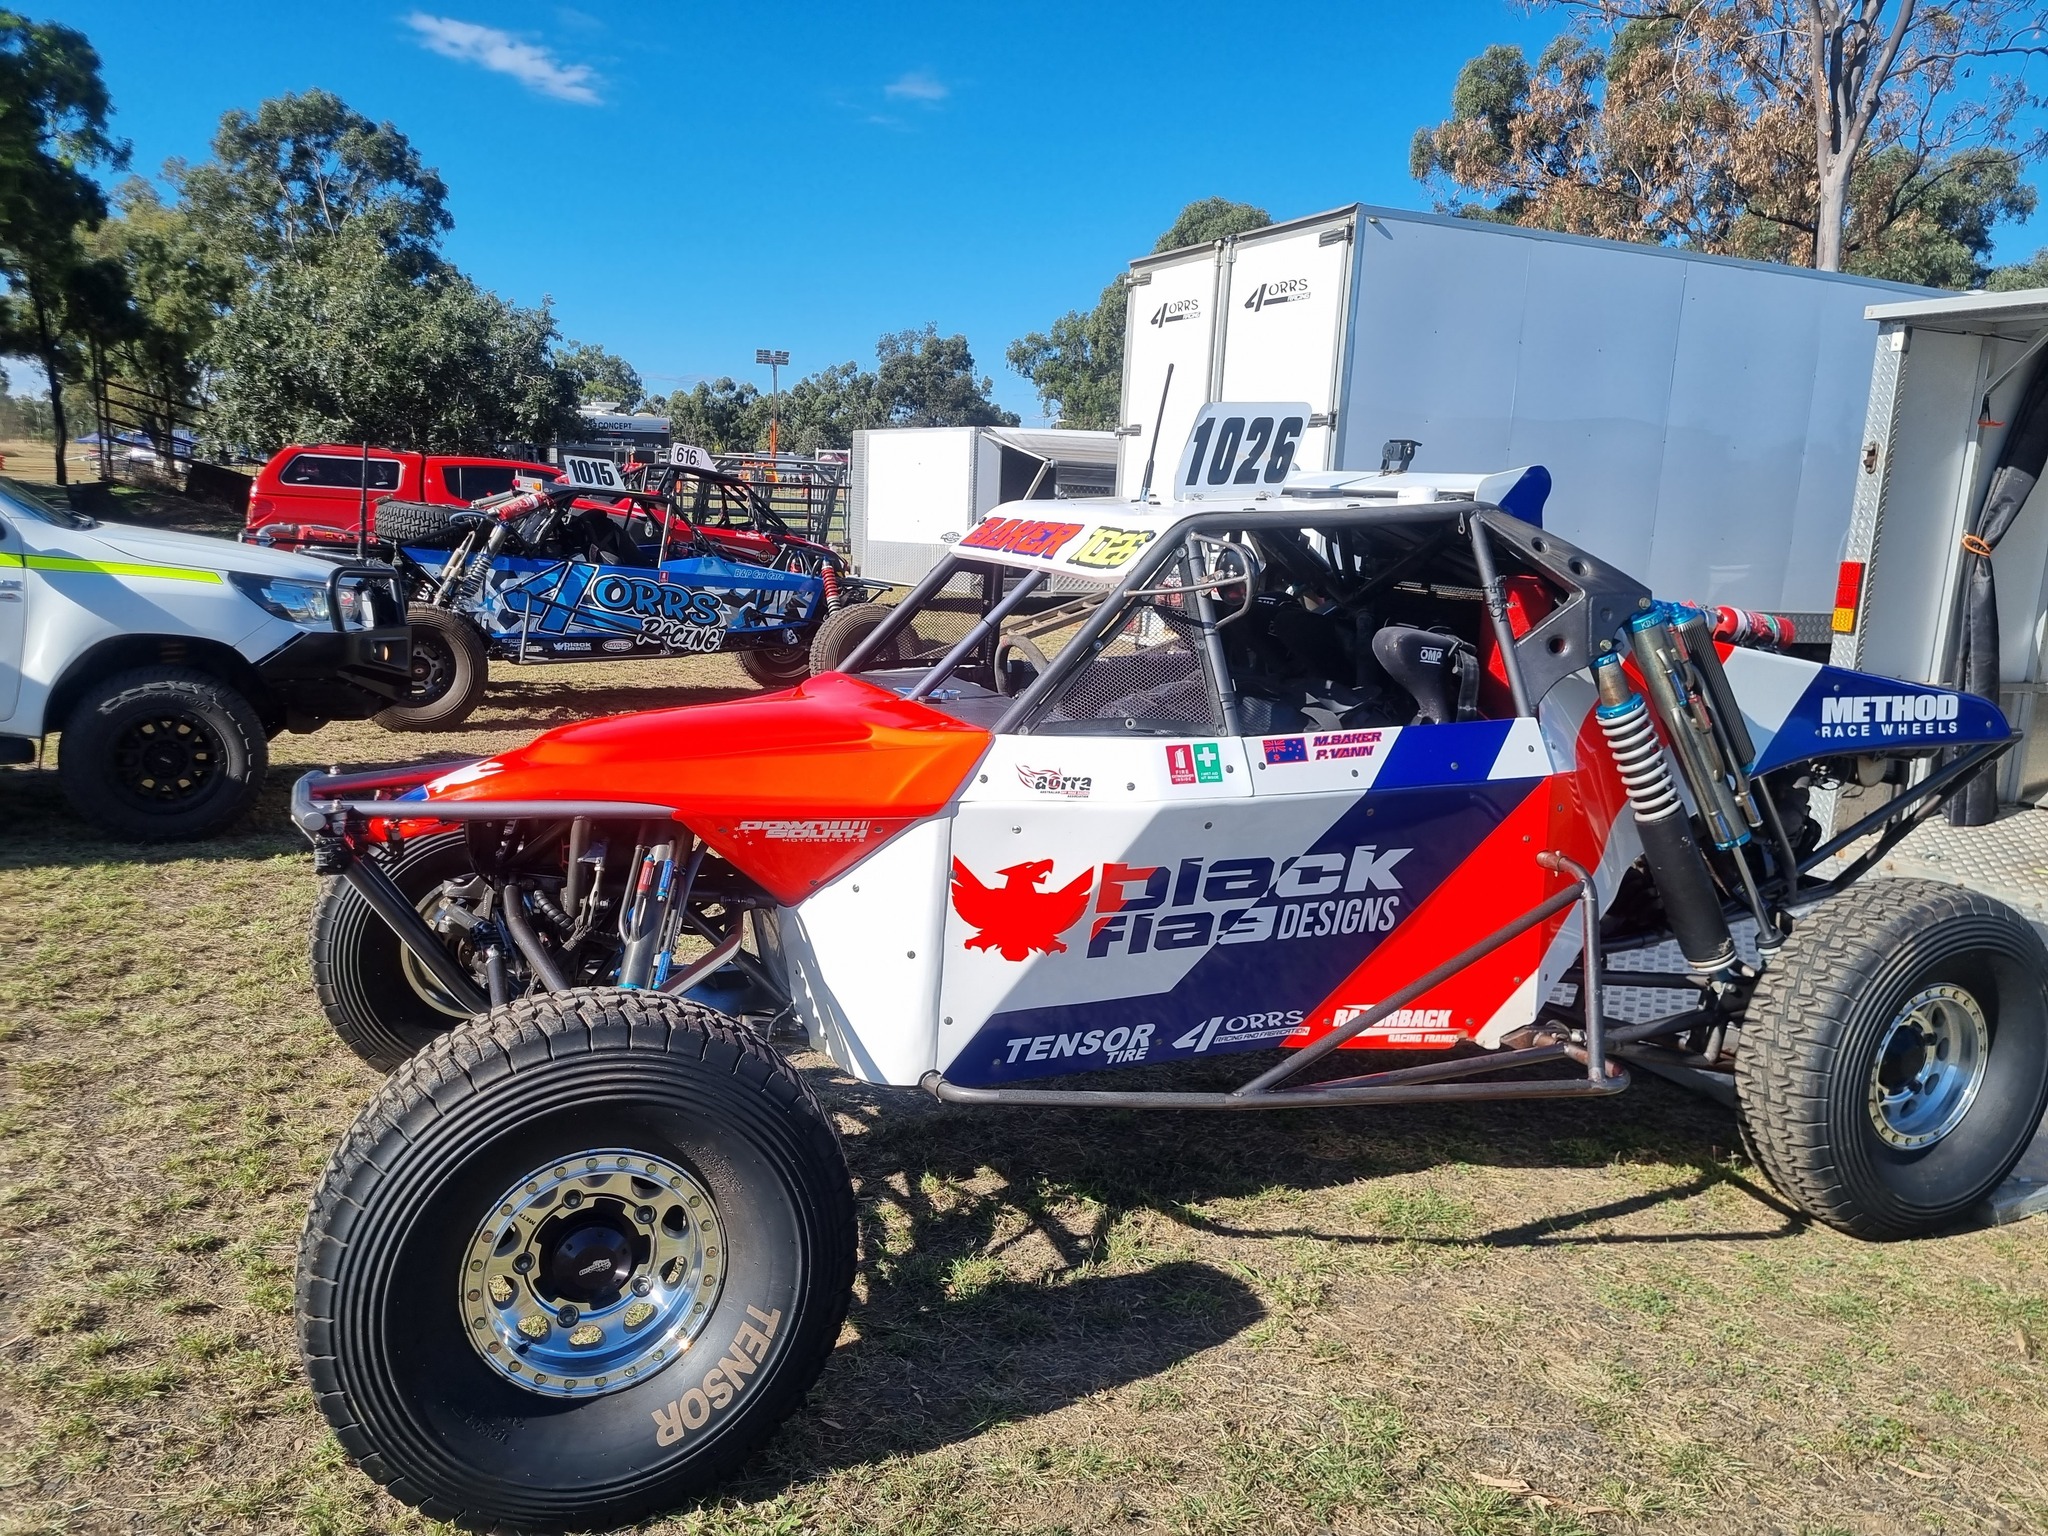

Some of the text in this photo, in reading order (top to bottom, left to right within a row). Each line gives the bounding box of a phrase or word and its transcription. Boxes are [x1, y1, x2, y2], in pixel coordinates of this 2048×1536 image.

[1268, 278, 1308, 296] ORRS
[1168, 299, 1199, 314] ORRS
[598, 421, 633, 430] CONCEPT
[1185, 416, 1304, 486] 1026
[569, 459, 615, 487] 1015
[959, 517, 1085, 560] BAKER
[592, 575, 724, 627] ORRS
[1420, 649, 1442, 662] OMP
[1822, 695, 1959, 724] METHOD
[1822, 722, 1958, 738] RACE WHEELS
[1313, 731, 1382, 747] M.BAKER
[1315, 745, 1374, 760] P.VANN
[1035, 775, 1092, 791] aorra
[765, 829, 868, 839] SOUTH
[1276, 895, 1400, 940] DESIGNS
[1332, 1009, 1453, 1028] RARBACK
[1172, 1010, 1304, 1053] 4 ORRS
[1215, 1027, 1309, 1043] RACING AND FABRICATION
[1387, 1034, 1422, 1043] RACING
[1006, 1023, 1156, 1064] TENSOR
[1106, 1047, 1149, 1064] TIRE
[651, 1304, 782, 1447] TENSOR
